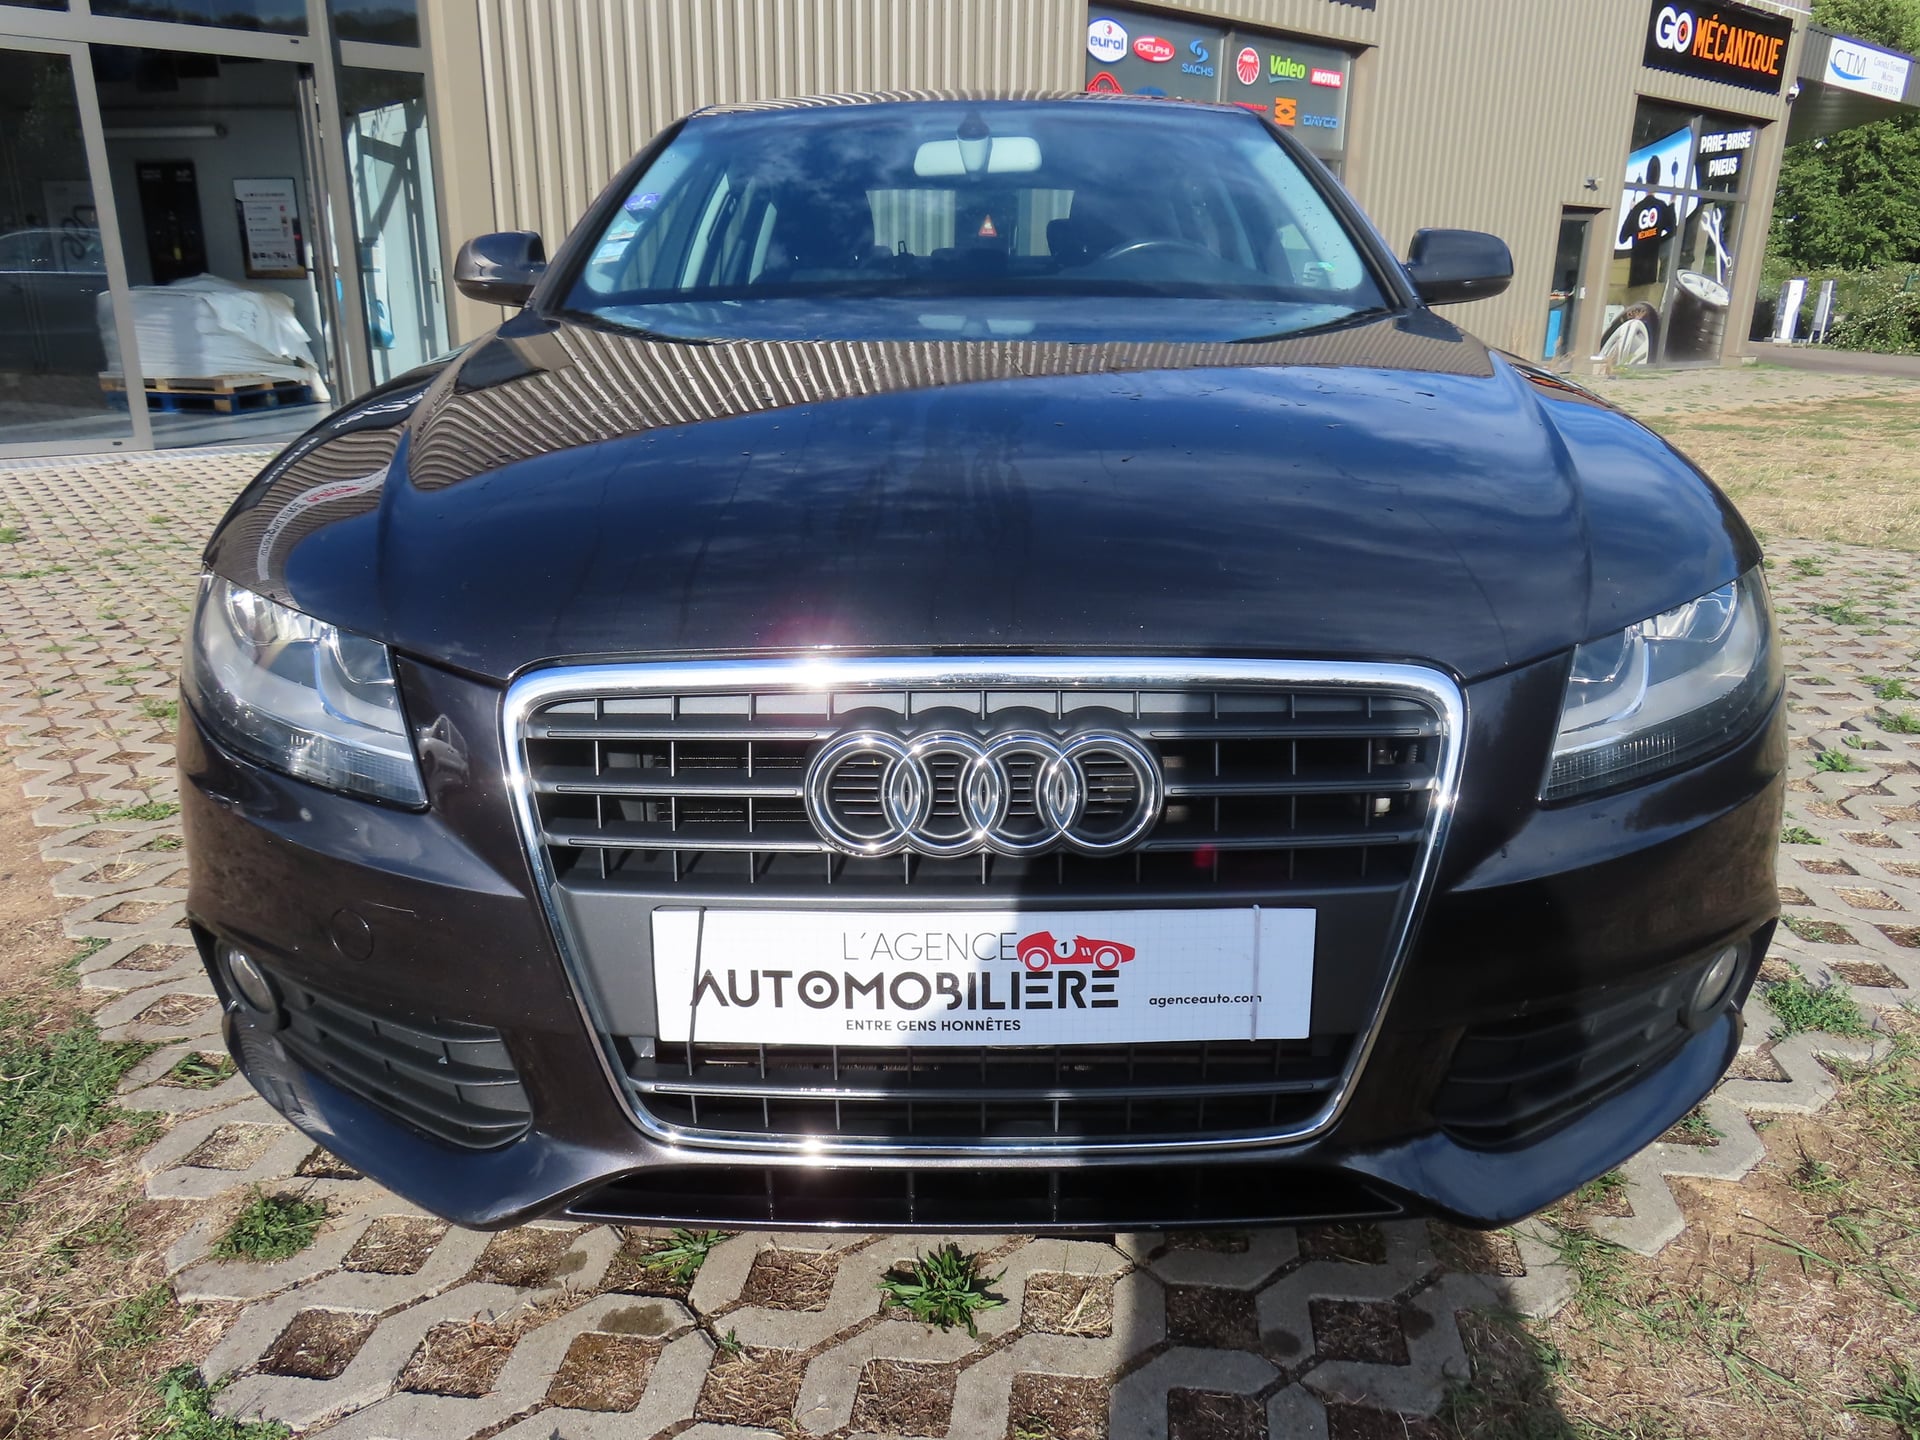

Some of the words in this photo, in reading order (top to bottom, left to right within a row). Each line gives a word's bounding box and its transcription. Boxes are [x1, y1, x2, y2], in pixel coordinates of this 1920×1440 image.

[1090, 36, 1124, 51] eurol
[1137, 42, 1171, 55] DELPHI
[1656, 6, 1693, 53] GO
[1692, 13, 1784, 75] MÉCANIQUE
[1181, 62, 1214, 77] SACHS
[1269, 54, 1306, 79] Valeo
[1833, 49, 1867, 76] CTM
[1311, 71, 1341, 86] MOTUL
[1303, 114, 1338, 129] DAYCO
[1700, 131, 1752, 153] PARE-BRISE
[1708, 157, 1738, 177] PNEUS
[1638, 207, 1658, 229] GO
[843, 932, 1018, 961] L'AGENCE
[1060, 941, 1068, 955] 1
[689, 969, 1120, 1011] AUTOMOBILIERE
[1149, 993, 1262, 1008] agenceauto.com
[846, 1019, 892, 1031] ENTRE
[897, 1020, 937, 1032] GENS
[941, 1017, 1021, 1031] HONNÊTES
